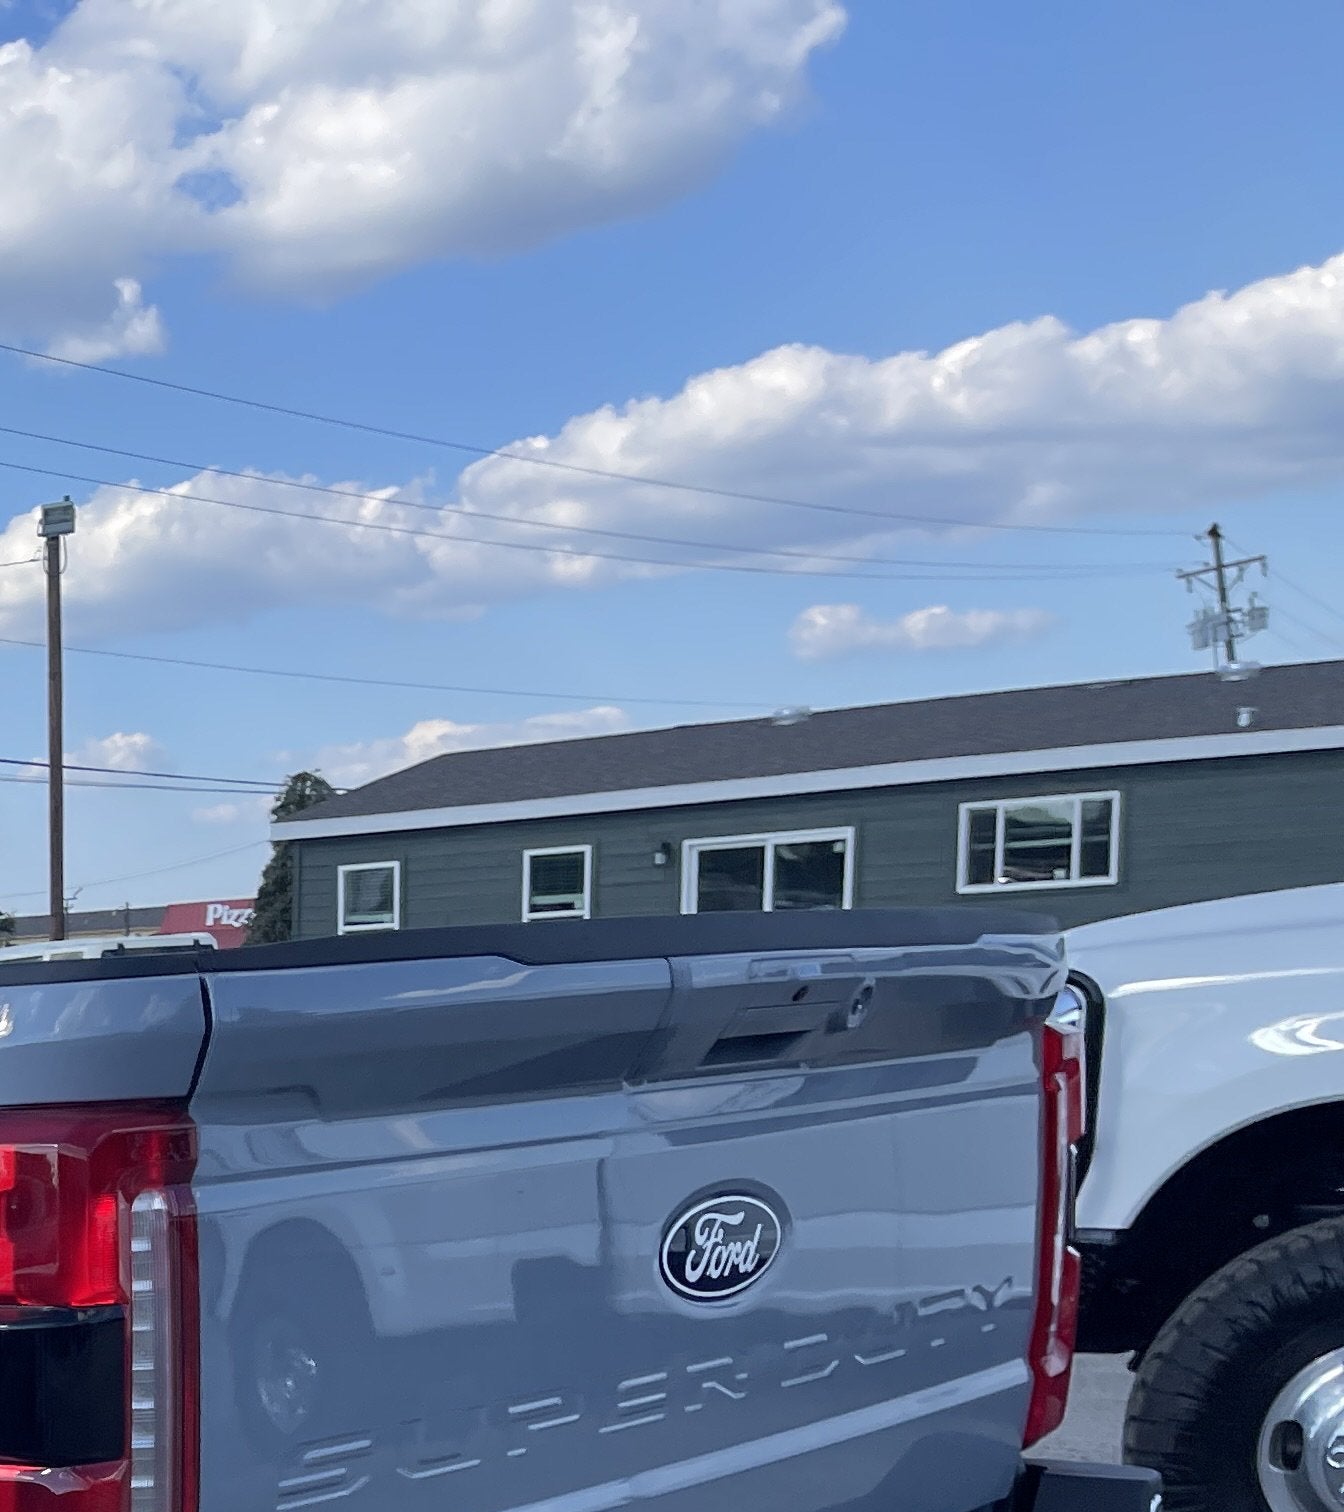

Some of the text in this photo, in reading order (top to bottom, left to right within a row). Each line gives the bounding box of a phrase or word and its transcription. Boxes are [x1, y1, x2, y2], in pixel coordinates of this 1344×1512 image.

[205, 904, 256, 928] Pizz
[685, 1211, 762, 1283] Ford
[275, 1275, 1013, 1511] SUPER DUTY
